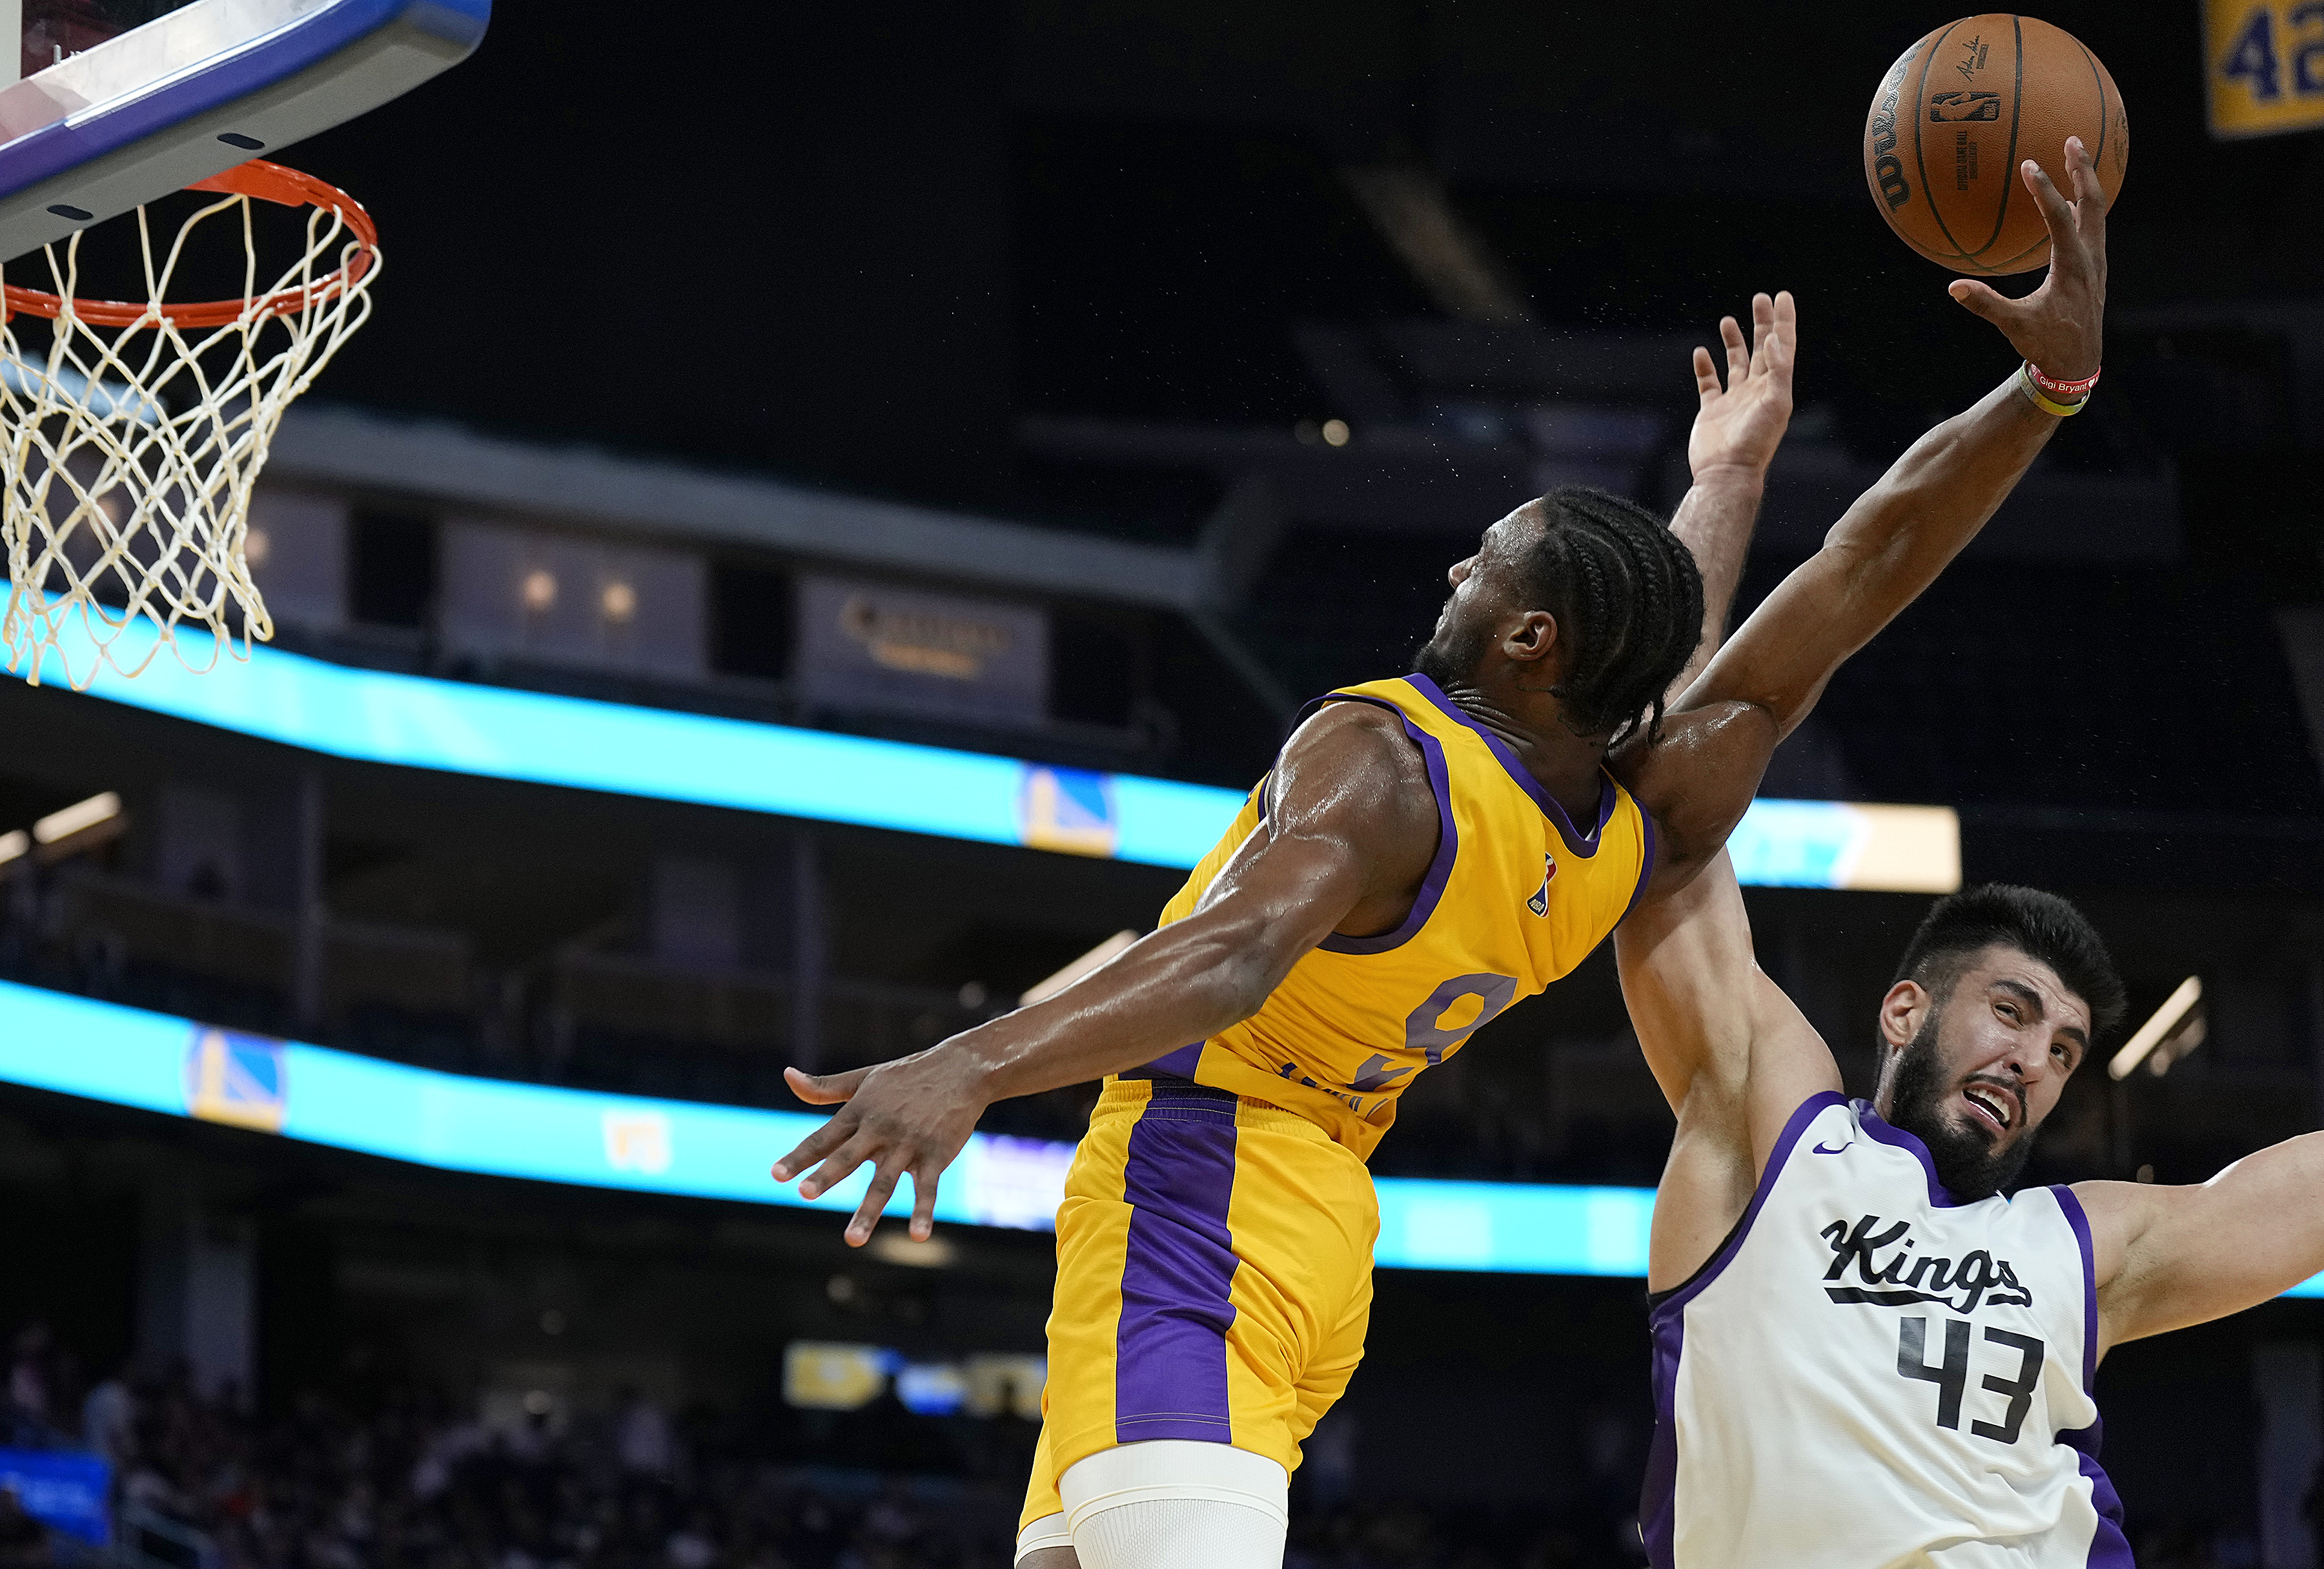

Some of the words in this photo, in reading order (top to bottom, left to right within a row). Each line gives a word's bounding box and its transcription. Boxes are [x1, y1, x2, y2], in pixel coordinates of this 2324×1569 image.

[1984, 103, 1997, 119] NBA
[1956, 131, 1967, 145] BALL
[2040, 376, 2056, 389] Gigi
[2058, 382, 2087, 393] Bryant
[1529, 898, 1545, 912] NBA
[1820, 1215, 2032, 1315] Kings
[1897, 1317, 2044, 1445] 43
